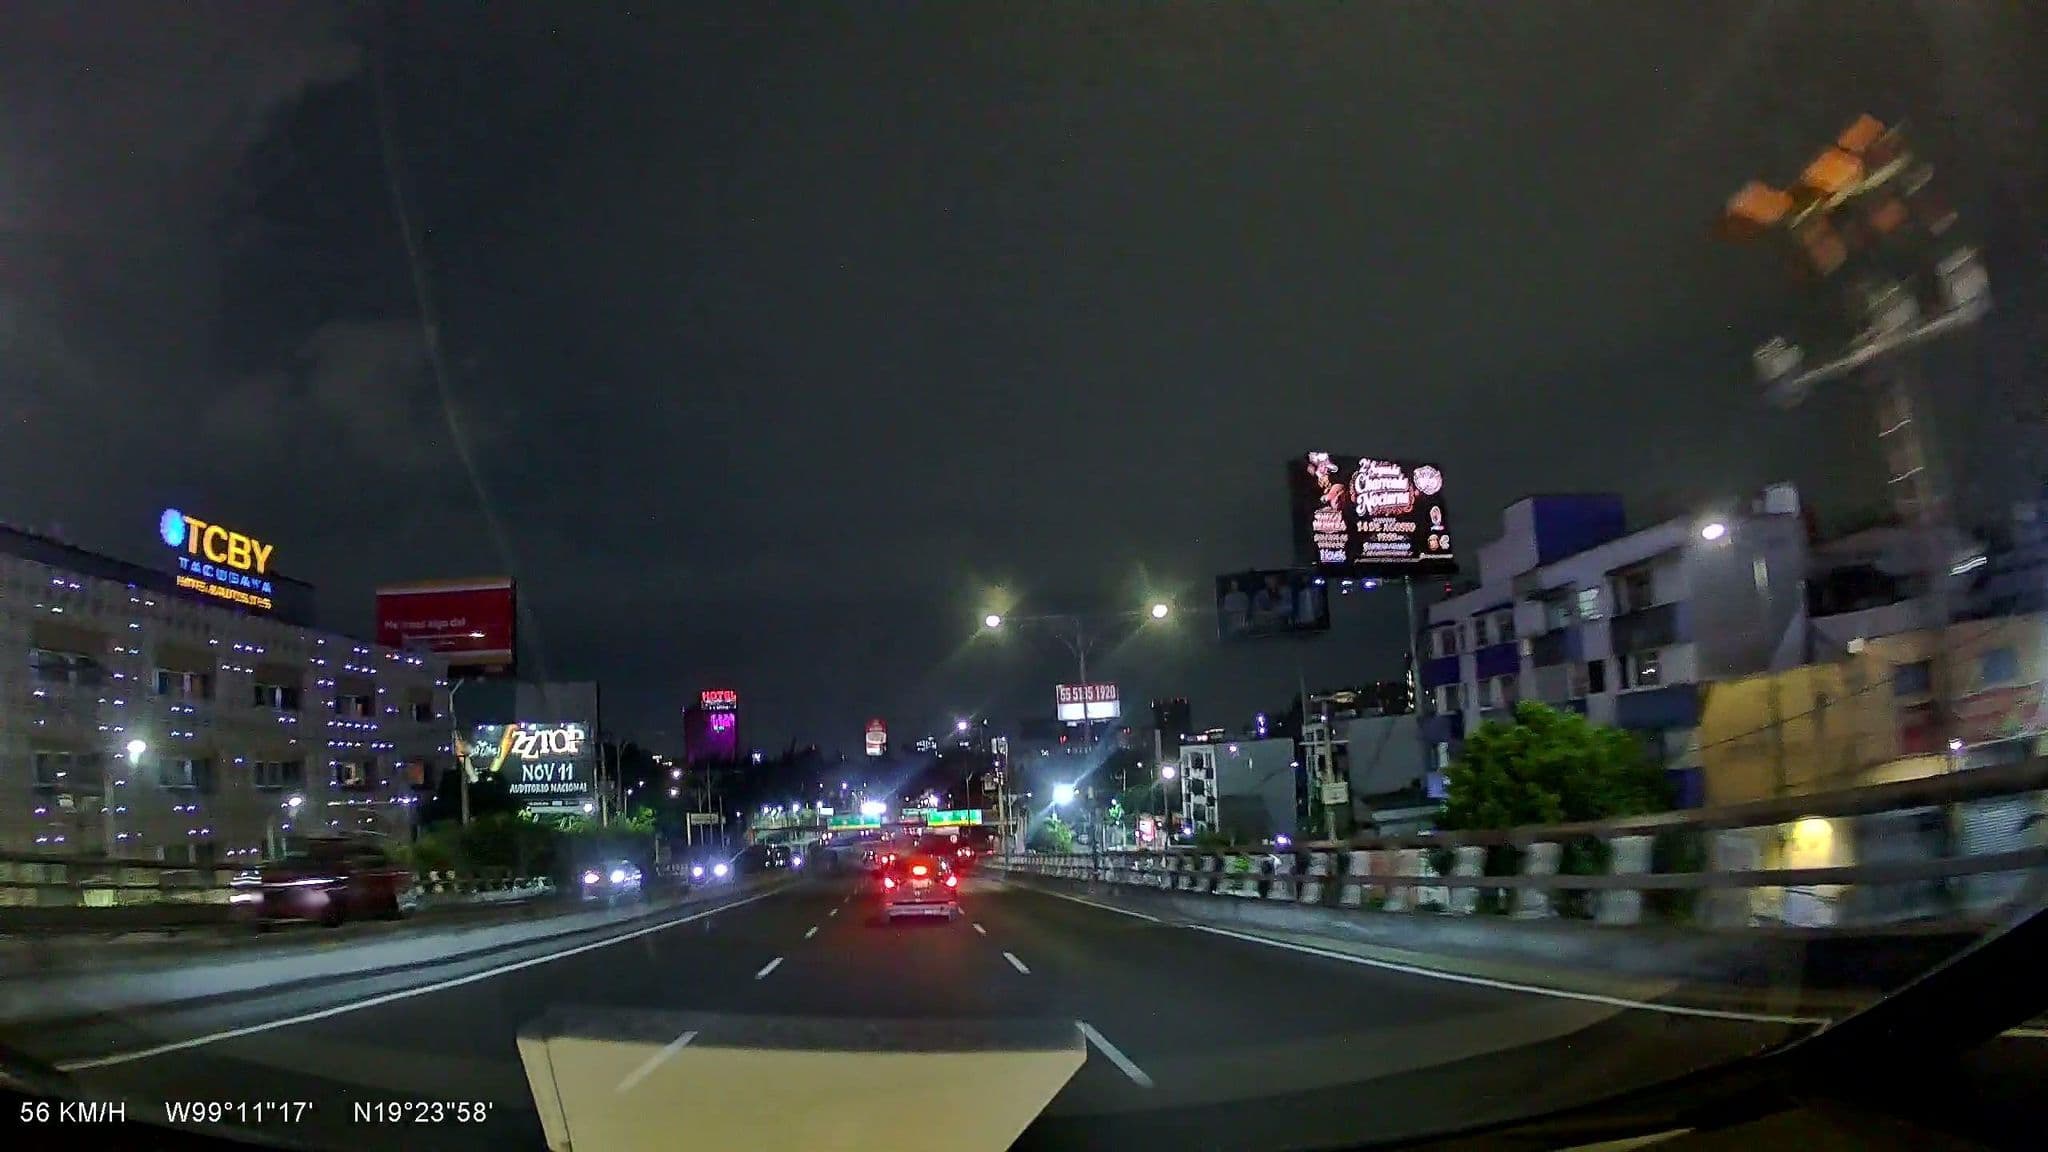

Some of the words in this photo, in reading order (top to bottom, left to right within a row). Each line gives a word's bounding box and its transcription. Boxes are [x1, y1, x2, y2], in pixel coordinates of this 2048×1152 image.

[183, 515, 273, 575] TCBY
[178, 556, 272, 593] TACUBAYA
[702, 690, 736, 703] HOTEL
[1095, 684, 1116, 700] 1920
[522, 763, 555, 781] NOV
[558, 763, 573, 781] 11
[509, 783, 549, 794] AUDITORIO
[550, 782, 587, 793] NACIONAL
